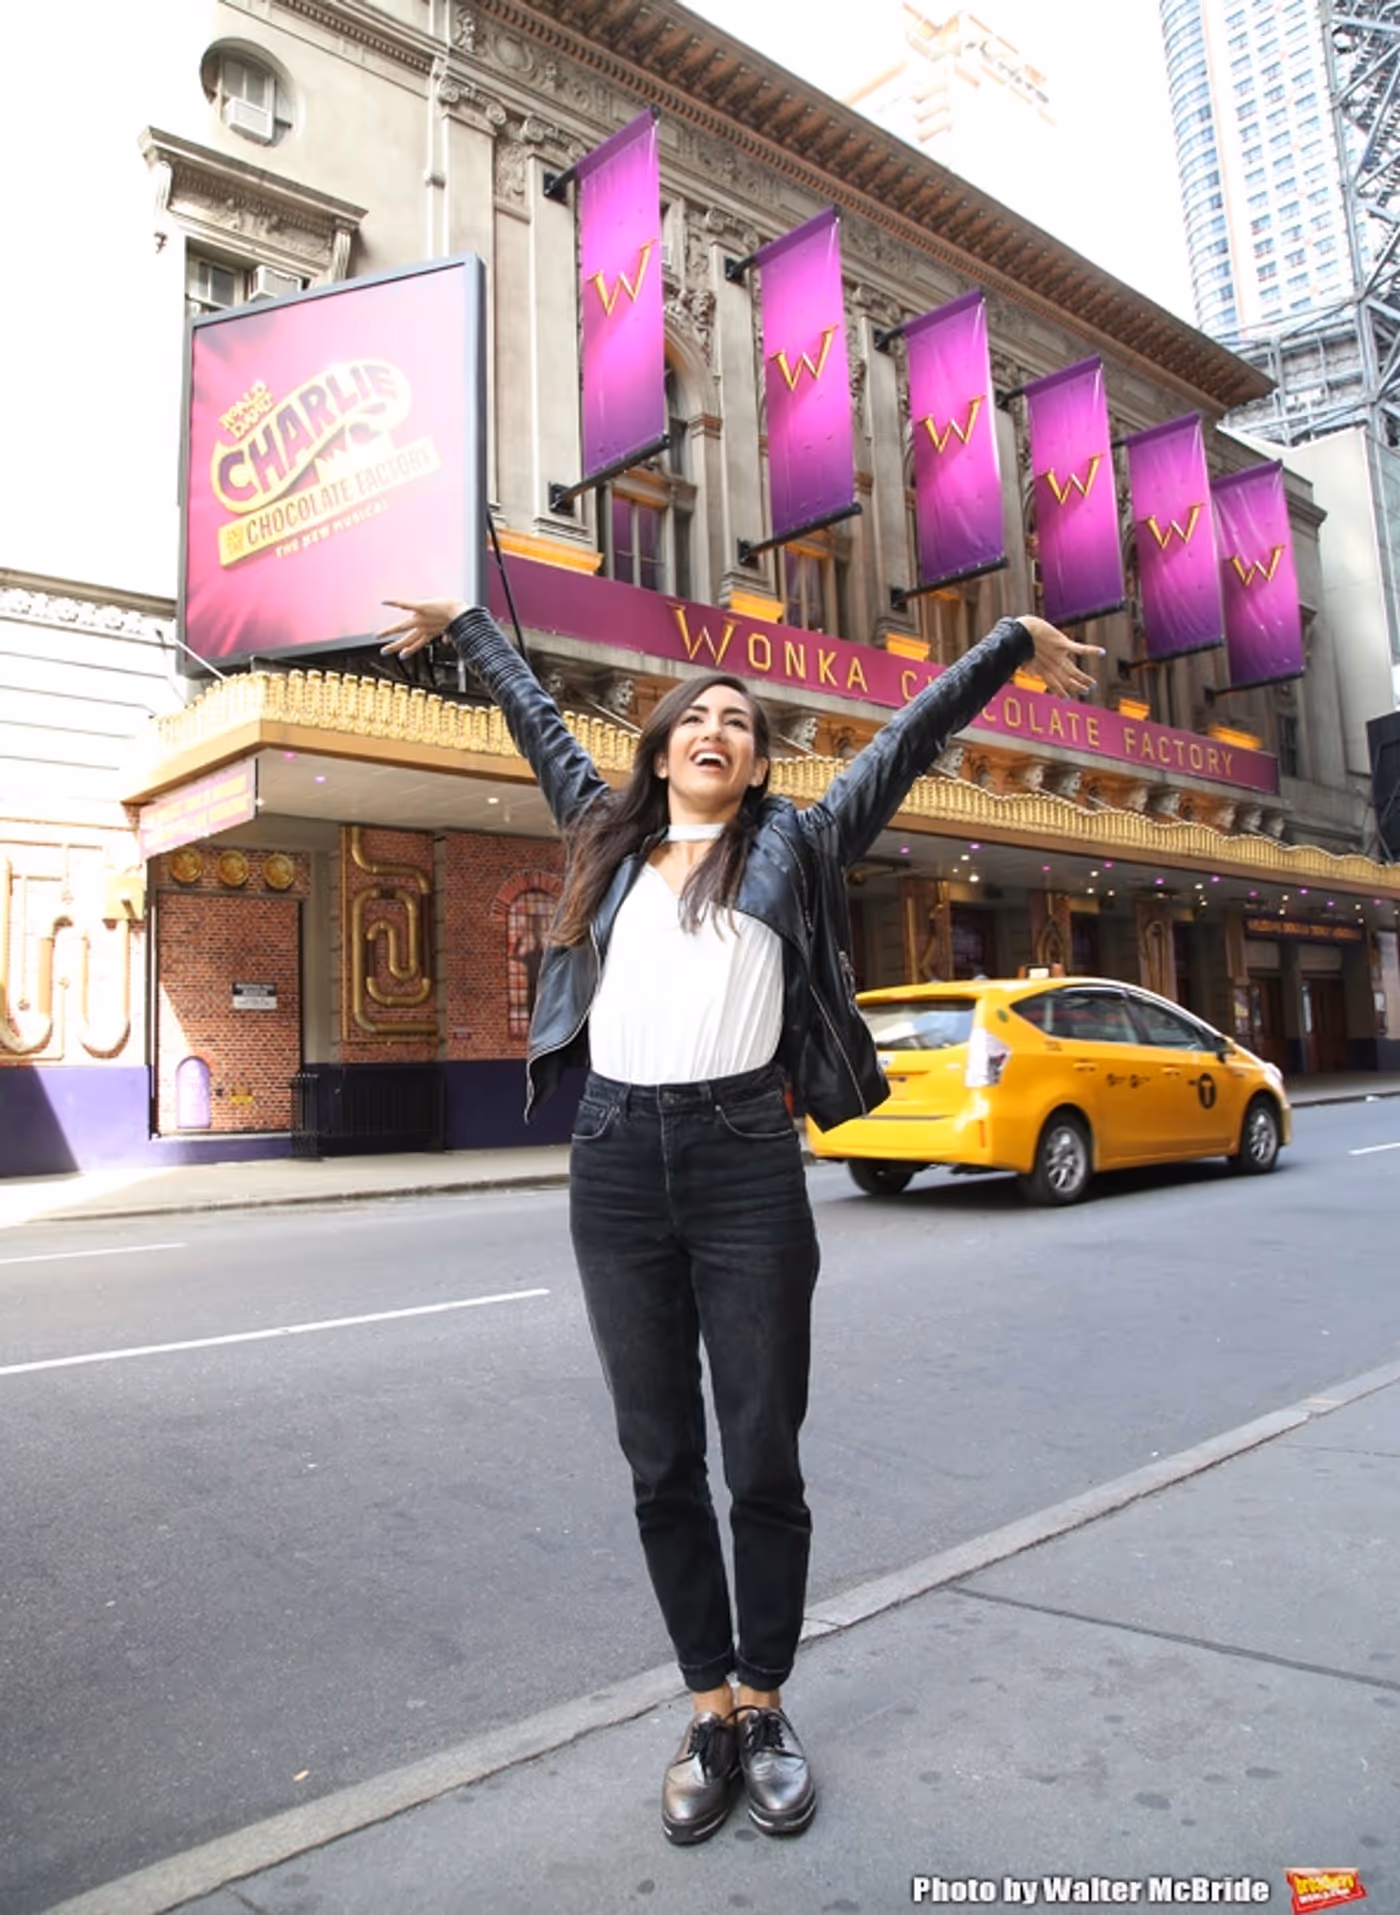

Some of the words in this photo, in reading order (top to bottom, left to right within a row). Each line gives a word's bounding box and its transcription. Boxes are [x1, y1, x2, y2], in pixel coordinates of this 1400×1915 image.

[588, 238, 654, 316] W
[769, 324, 839, 391] W
[218, 363, 398, 501] CHARLIE
[920, 394, 986, 453] W
[246, 480, 353, 545] CHOCOLATE
[355, 447, 433, 497] FACTORY
[1041, 453, 1104, 505] W
[1141, 503, 1203, 549] W
[1228, 544, 1286, 586] W
[667, 602, 869, 694] WONKA
[901, 669, 1100, 747] COLATE
[1124, 727, 1234, 777] FACTORY
